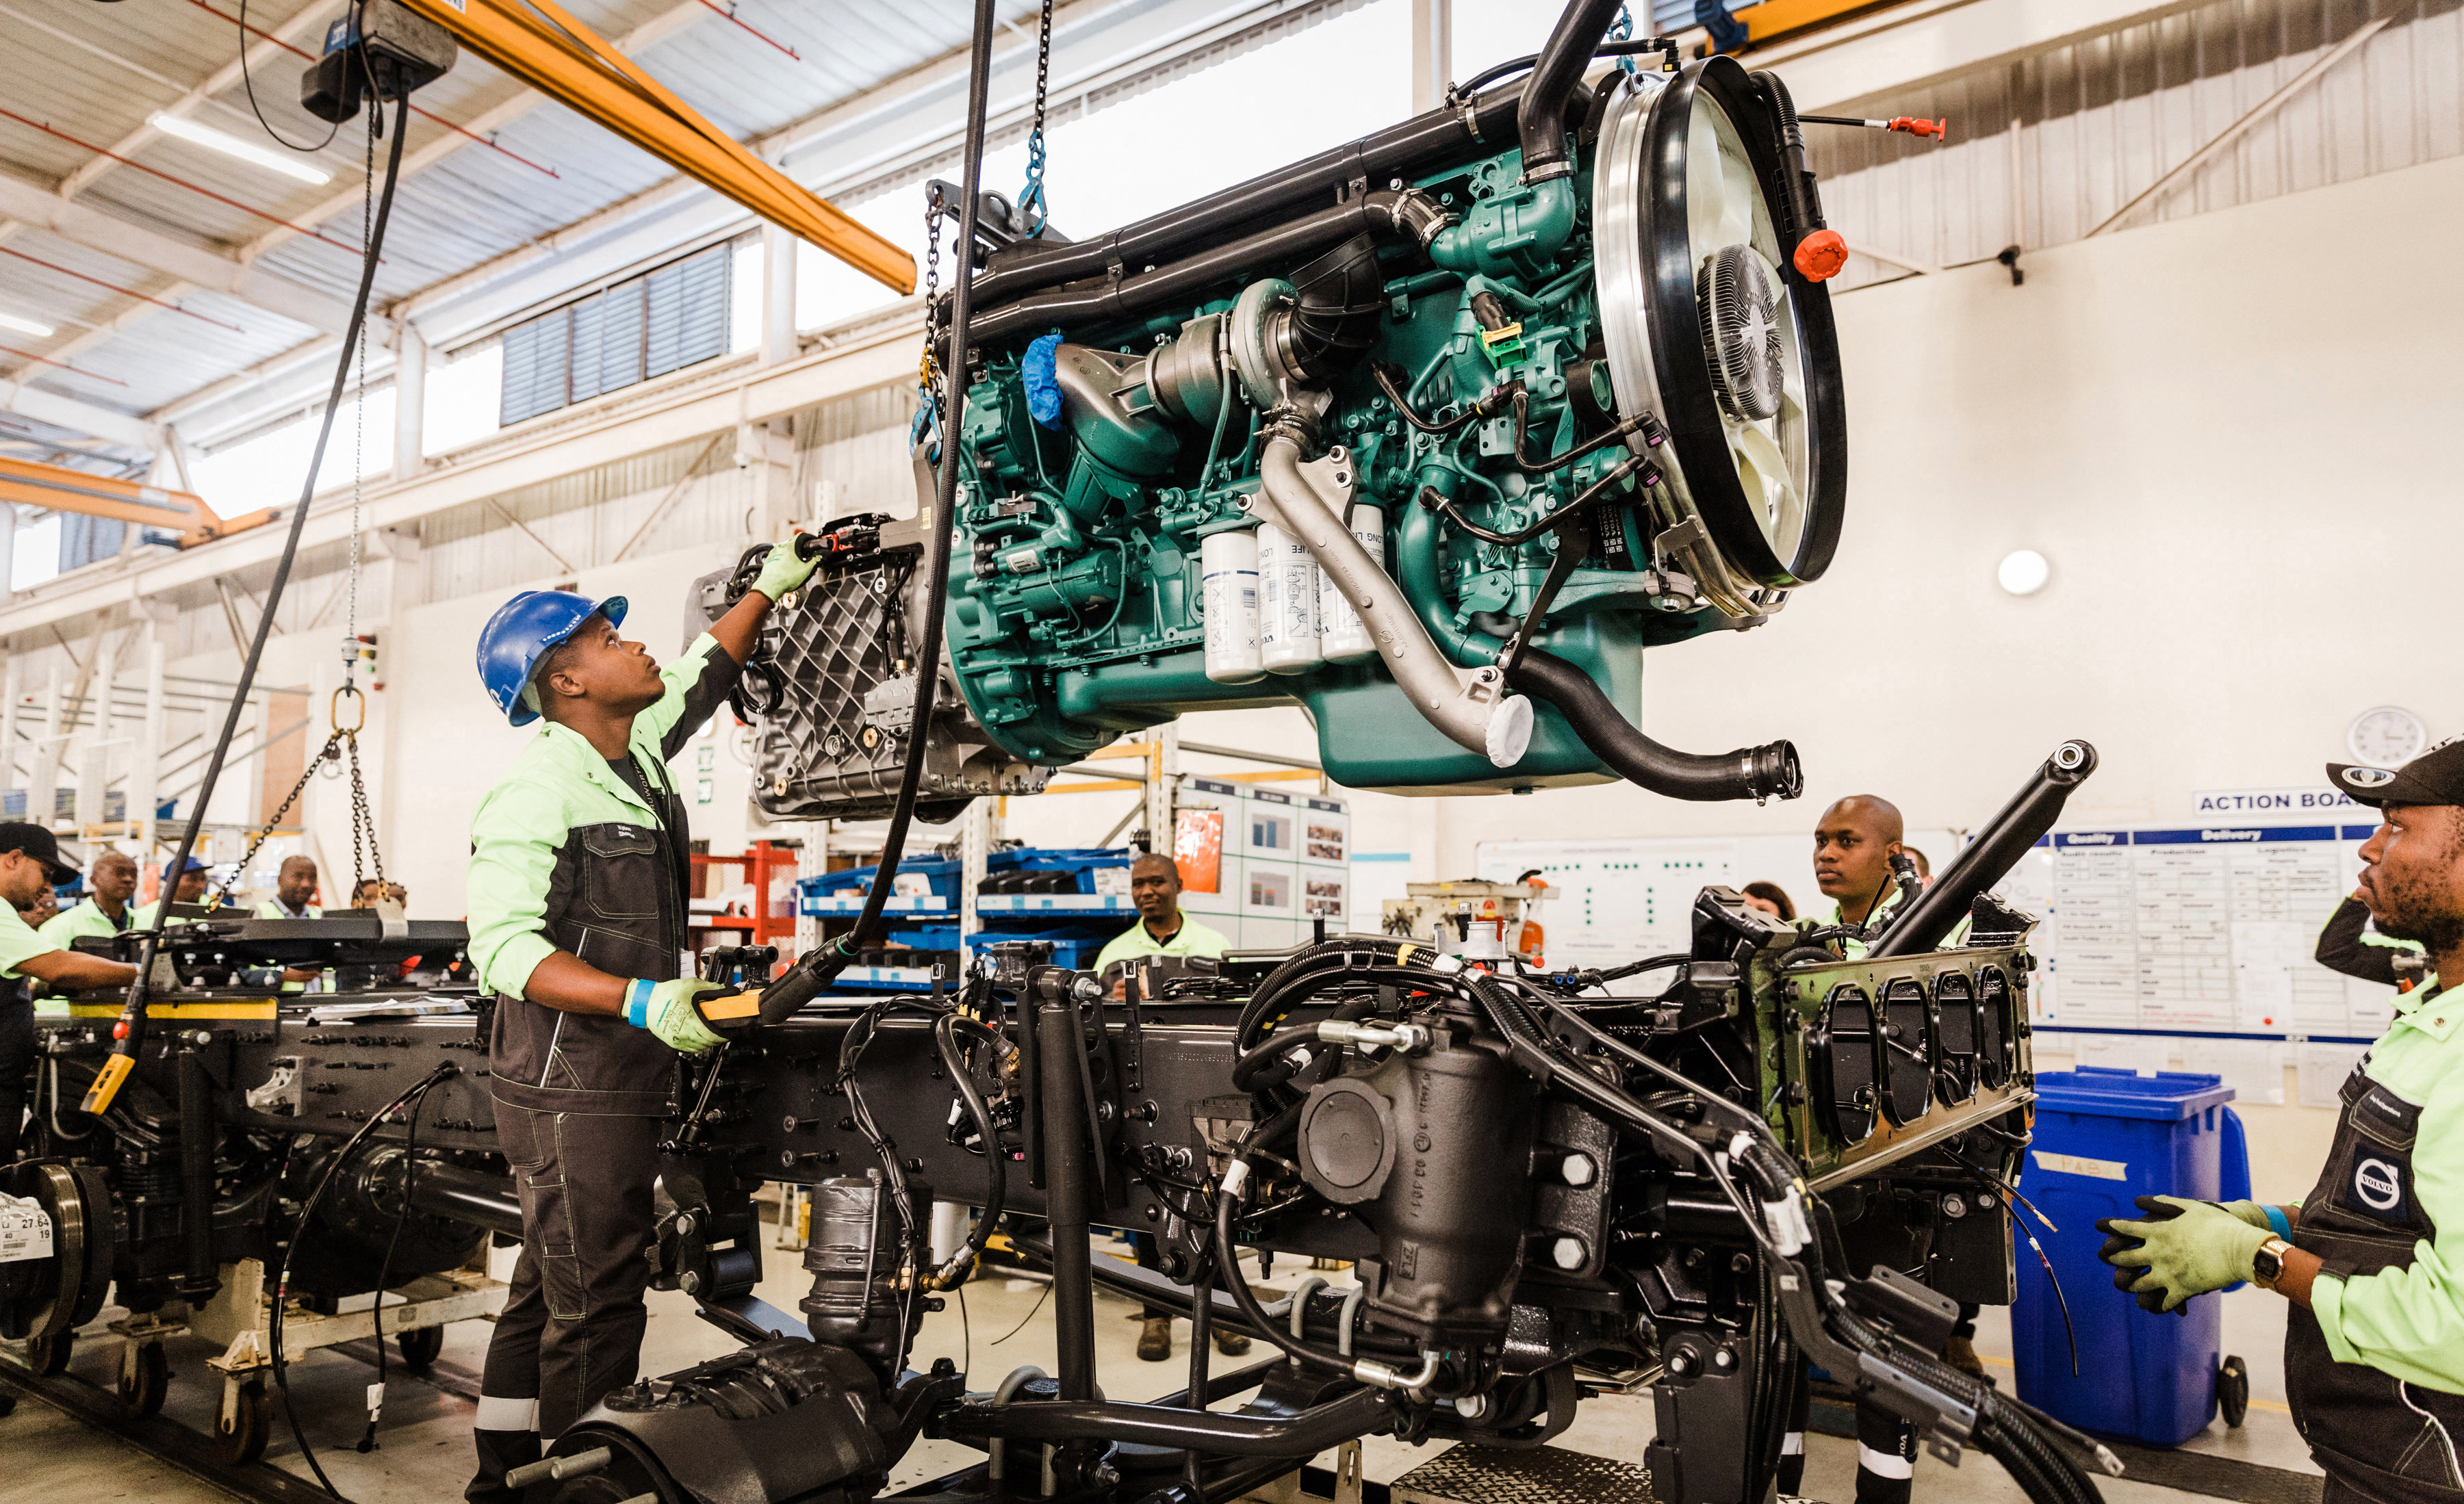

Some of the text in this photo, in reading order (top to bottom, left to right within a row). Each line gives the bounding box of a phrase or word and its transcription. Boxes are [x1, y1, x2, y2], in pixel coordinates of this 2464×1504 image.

[1352, 532, 1363, 541] LI
[2200, 793, 2359, 810] ACTION BOA
[2066, 833, 2116, 845] Quality
[2201, 829, 2262, 842] Delivery
[2362, 1176, 2392, 1191] VOLVO
[22, 1219, 49, 1229] 27.64
[40, 1230, 50, 1239] 19
